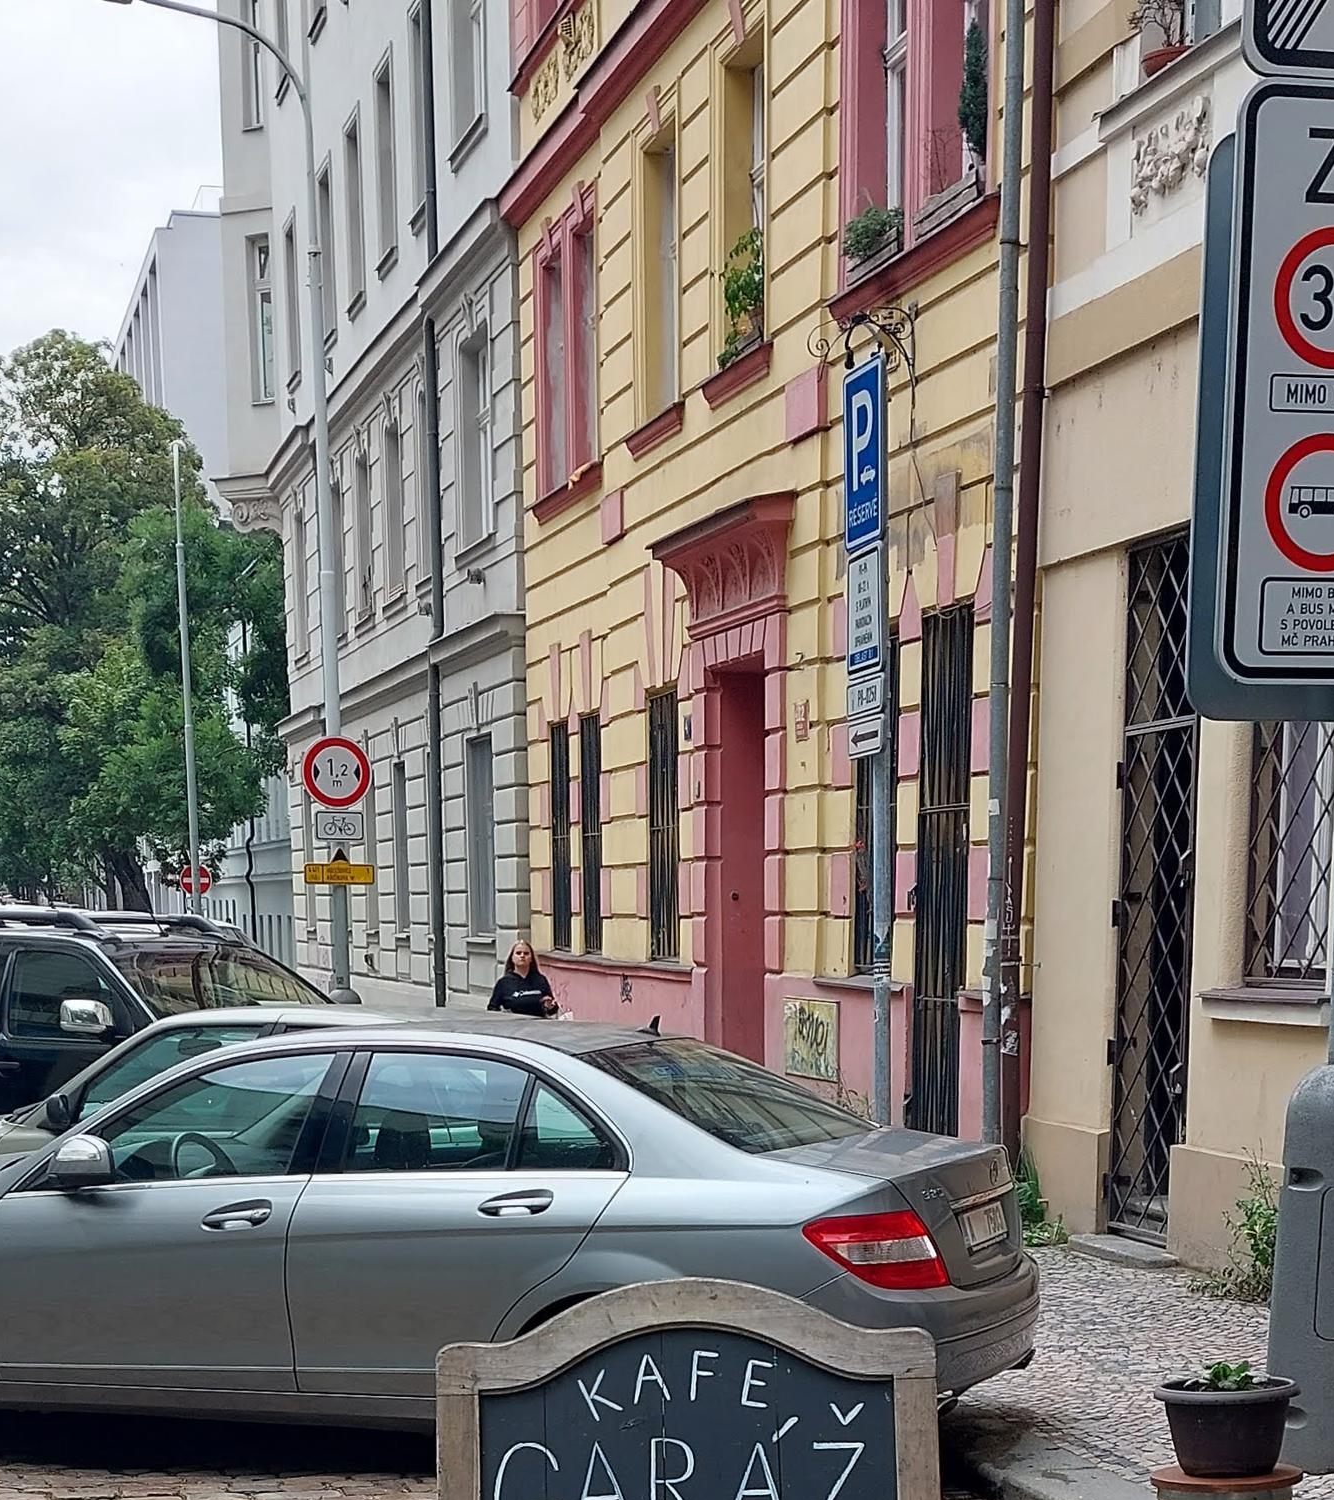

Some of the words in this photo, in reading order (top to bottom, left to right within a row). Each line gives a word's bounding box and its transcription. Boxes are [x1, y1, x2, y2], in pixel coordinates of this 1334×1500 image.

[1286, 383, 1327, 404] MIMO
[852, 389, 873, 492] P
[848, 492, 878, 529] RÉSERVÉ
[1292, 587, 1323, 599] MIMO
[1286, 603, 1295, 614] A
[1300, 603, 1324, 614] BUS
[1280, 619, 1288, 630] S
[1281, 633, 1299, 646] MČ
[327, 758, 348, 778] 1,2
[332, 779, 342, 788] m
[577, 1350, 775, 1422] KAFE
